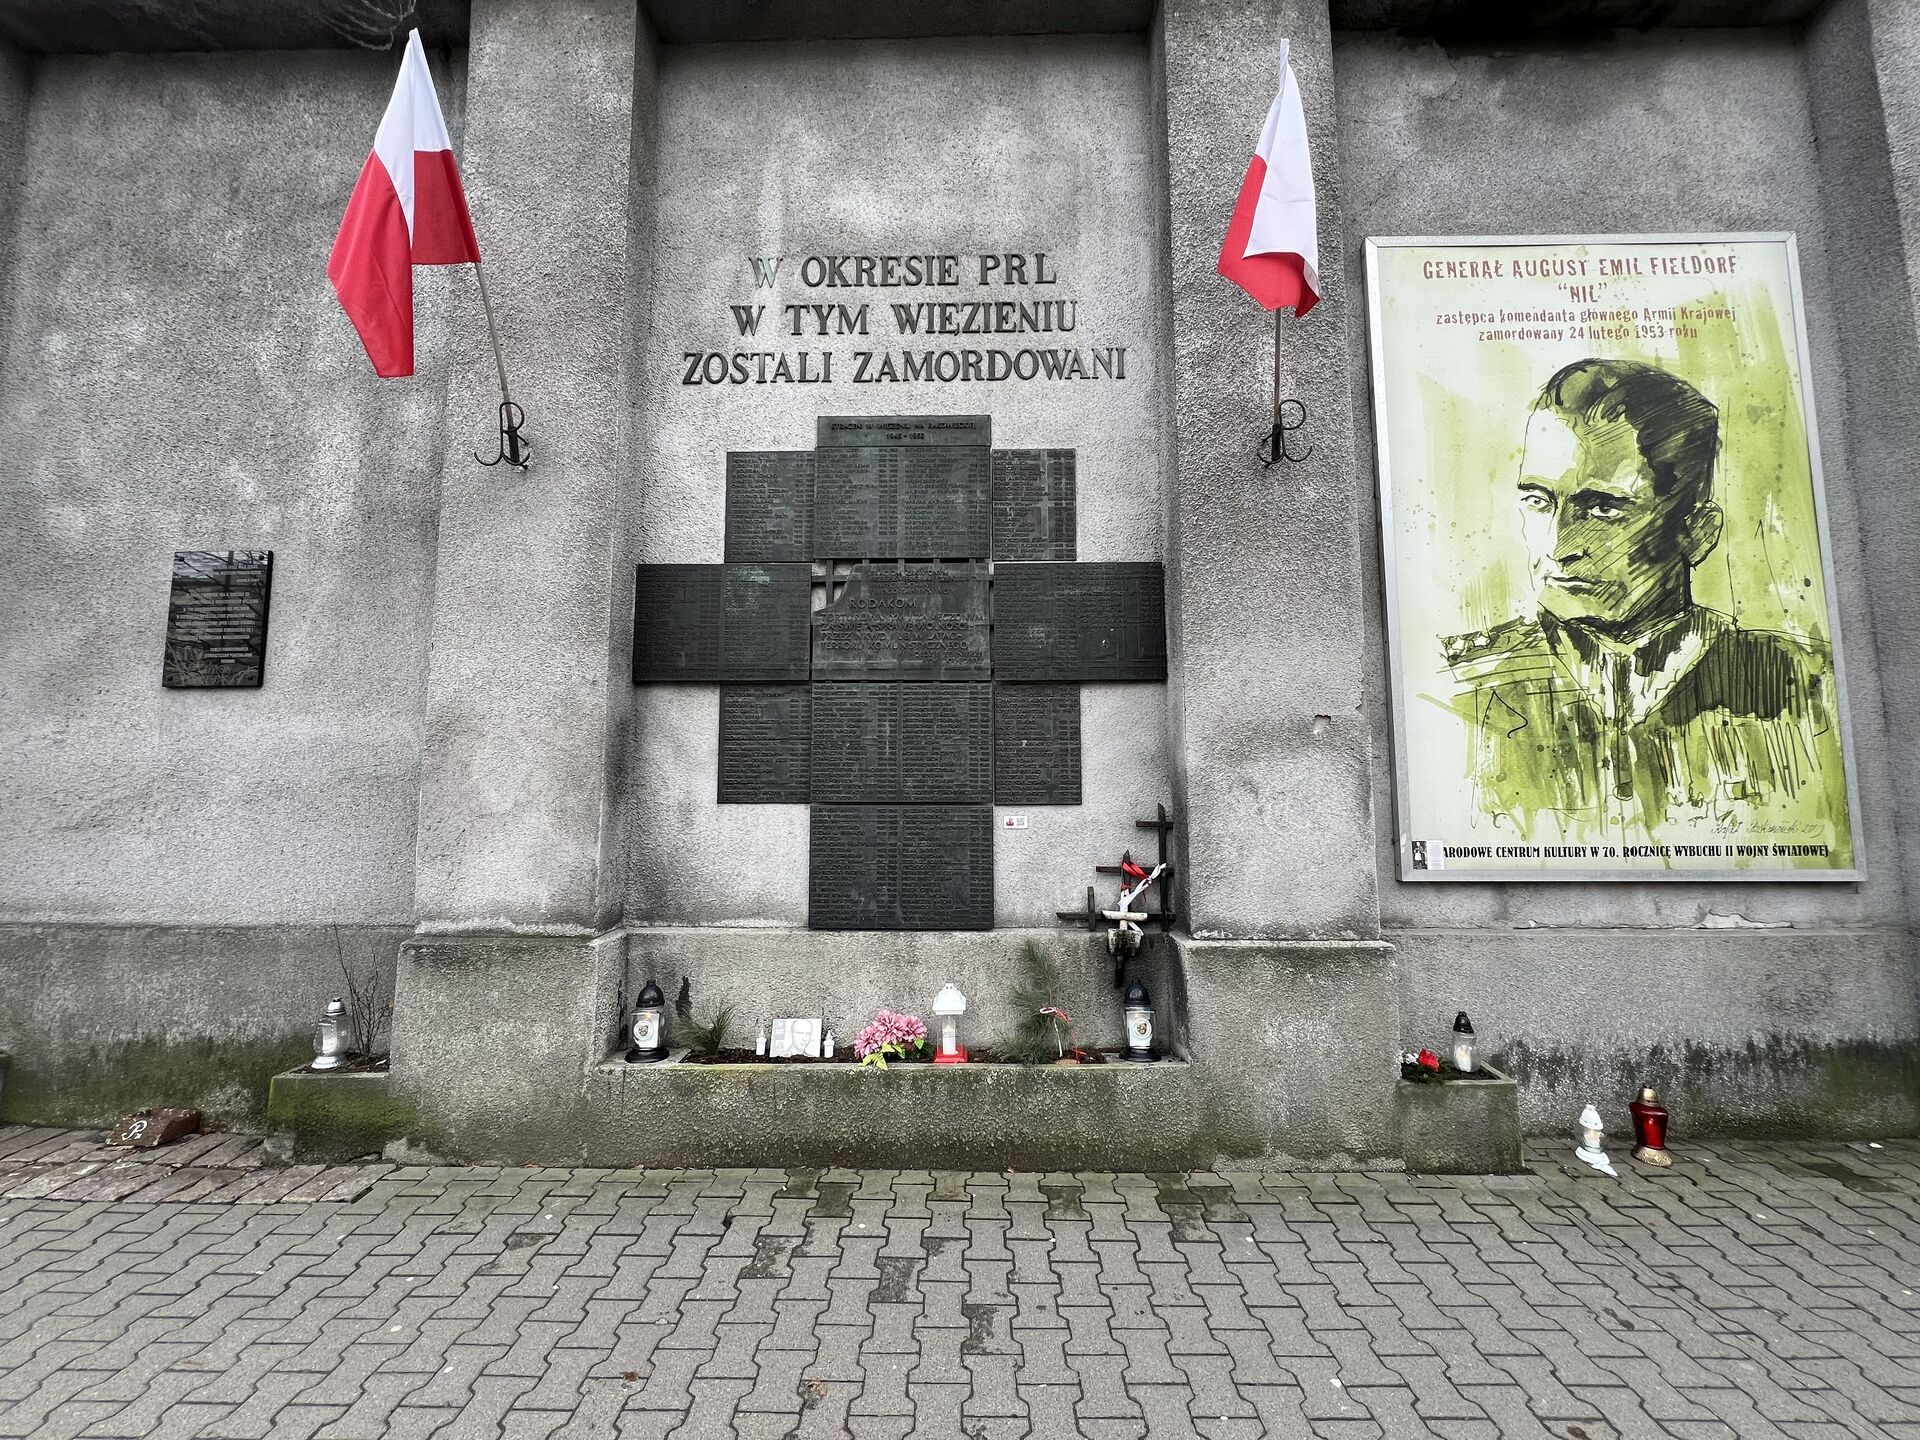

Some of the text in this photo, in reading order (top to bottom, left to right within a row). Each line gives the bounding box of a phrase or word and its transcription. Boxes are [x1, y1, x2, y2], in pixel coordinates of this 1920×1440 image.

[748, 253, 1057, 288] W OKRESIE PRL
[1423, 255, 1737, 280] GENERAŁ AUGUST EMIL FIELDORF
[731, 301, 1077, 337] W TYM WIĘZIENIU
[1436, 305, 1737, 326] zastępca komendanta głównego Armii Krajowej
[1479, 323, 1698, 343] zamordowany 24 lutego 1953 roku
[682, 347, 1127, 385] ZOSTALI ZAMORDOWANI
[849, 598, 917, 609] RODAKOM
[1443, 845, 1492, 858] ARODOWE
[1496, 846, 1540, 858] CENTRUM
[1544, 846, 1587, 858] KULTURY
[1590, 846, 1600, 858] W
[1603, 846, 1619, 858] 70.
[1622, 845, 1671, 859] ROCZNICĘ
[1674, 845, 1722, 857] WYBUCHU
[1725, 845, 1733, 857] II
[1736, 845, 1769, 858] WOJNY
[1772, 842, 1829, 858] ŚWIATOWEJ
